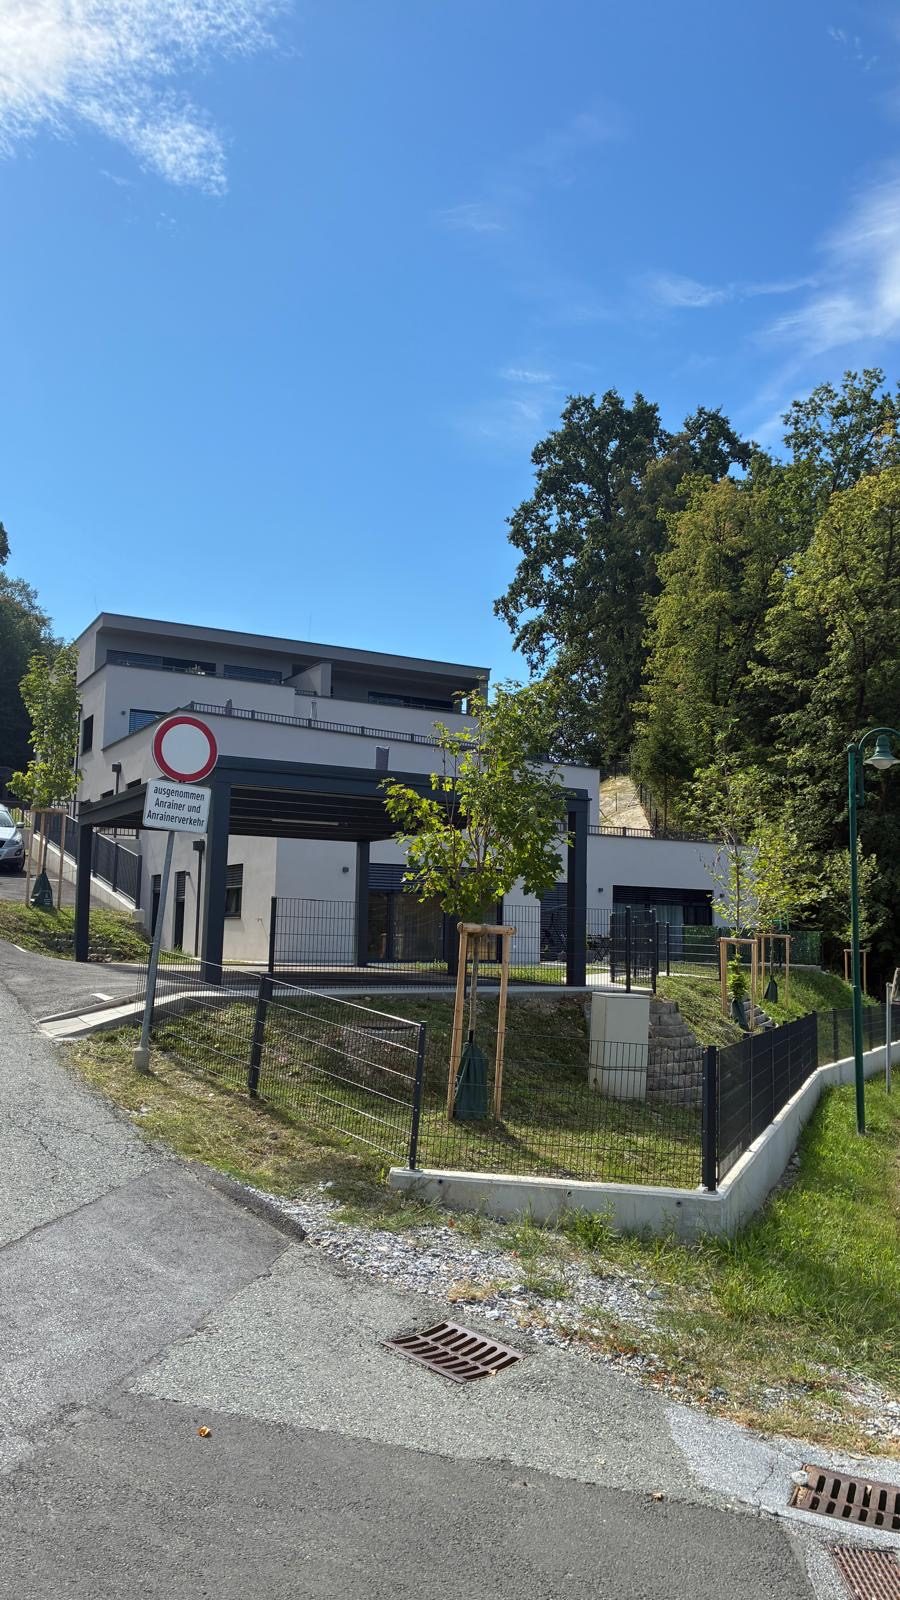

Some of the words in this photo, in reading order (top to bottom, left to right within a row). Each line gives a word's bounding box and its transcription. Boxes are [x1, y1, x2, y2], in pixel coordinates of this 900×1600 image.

[153, 786, 205, 801] ausgenommen
[154, 797, 186, 811] Anrainer
[187, 804, 201, 814] und
[146, 809, 205, 827] Anrainerverkehr
